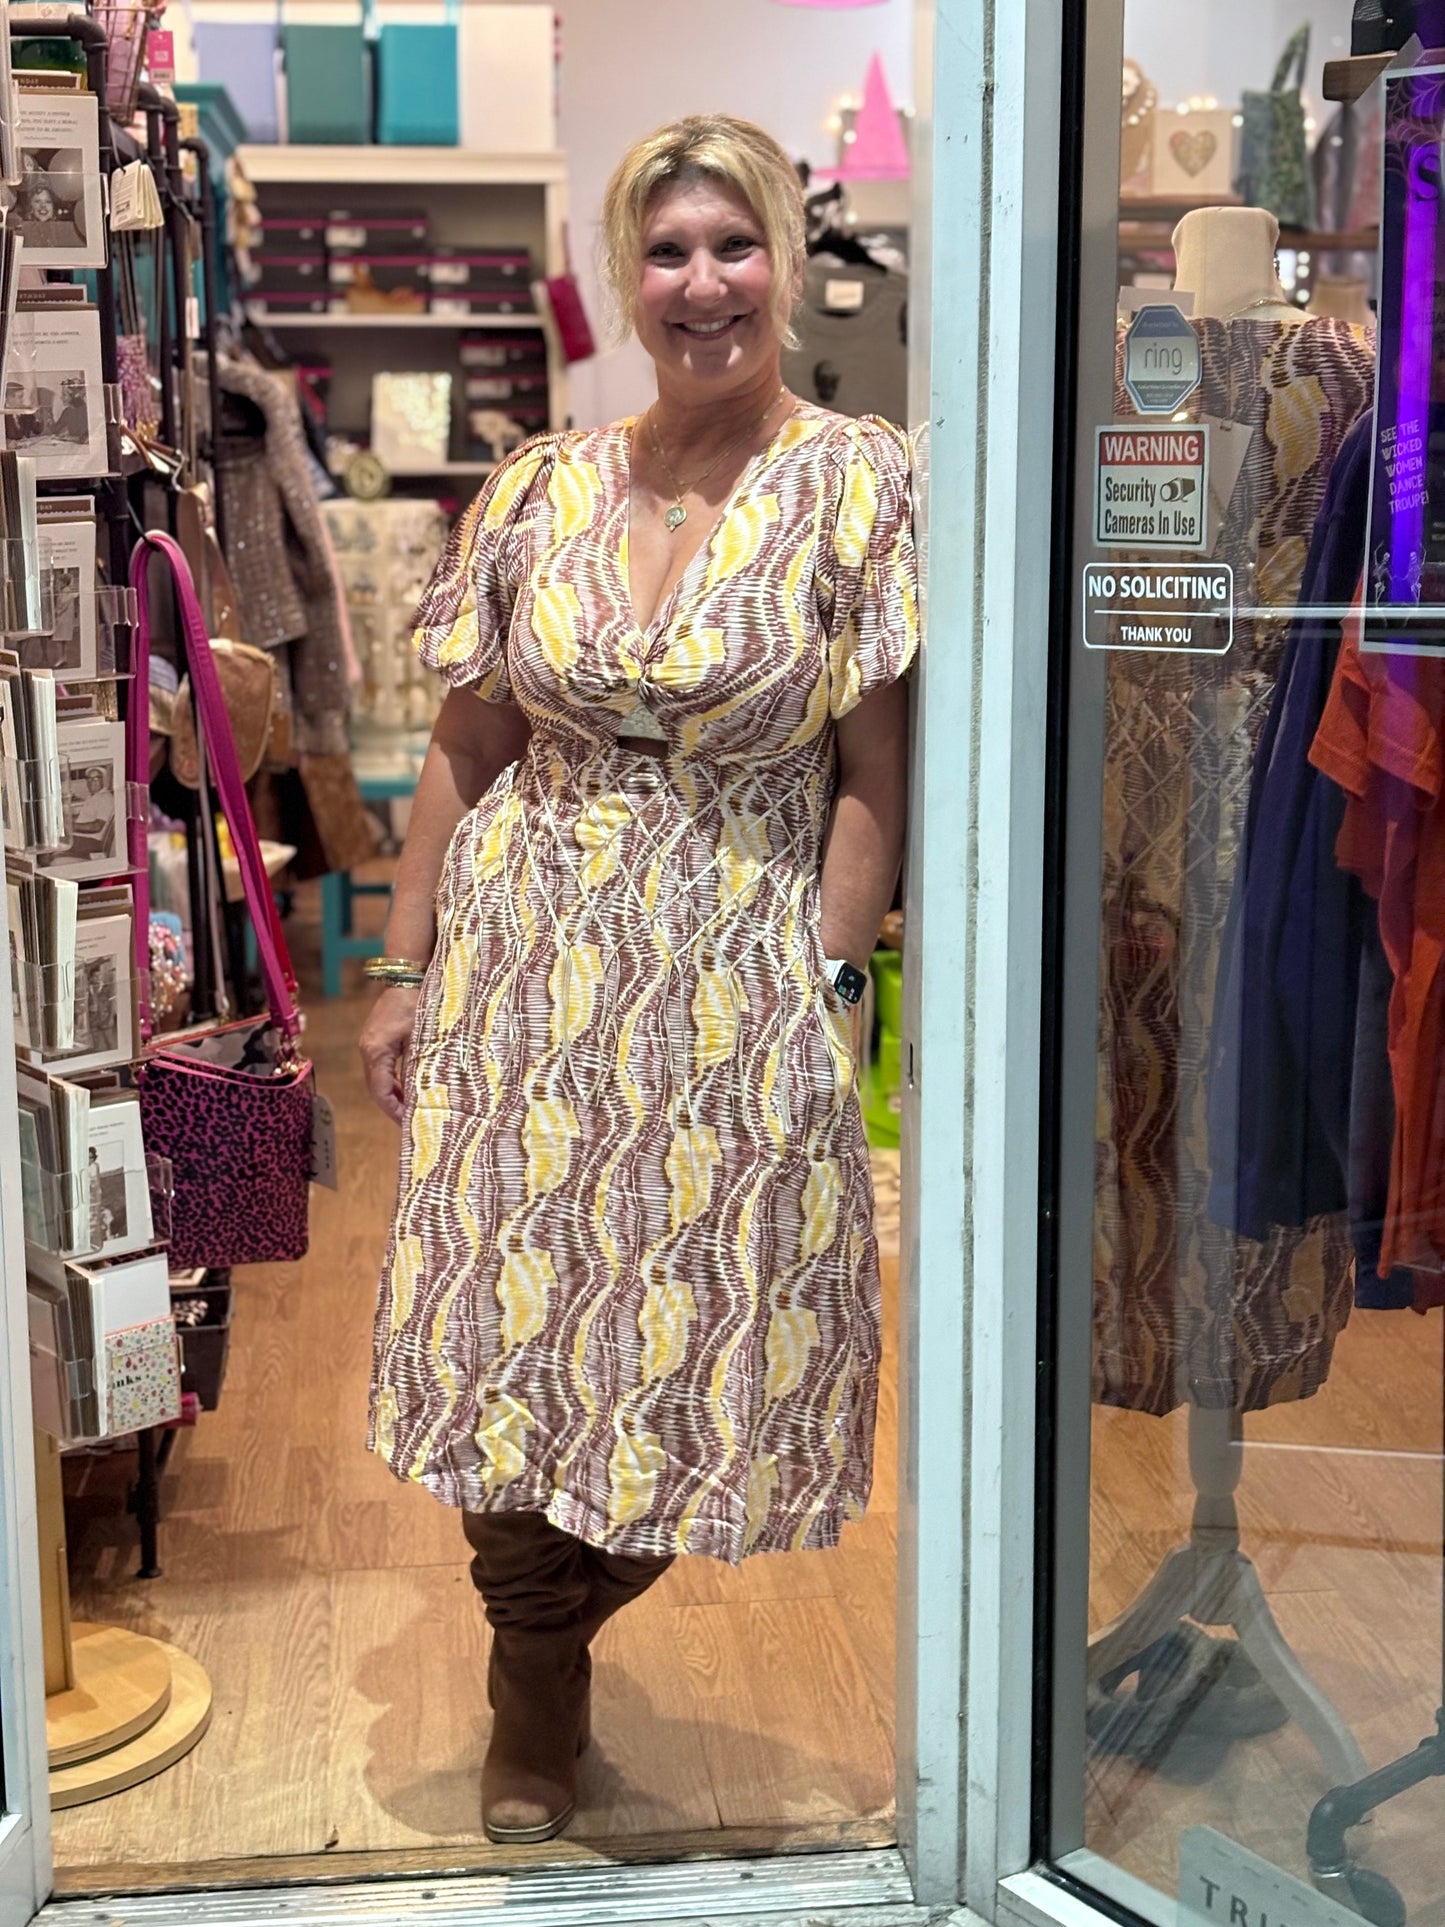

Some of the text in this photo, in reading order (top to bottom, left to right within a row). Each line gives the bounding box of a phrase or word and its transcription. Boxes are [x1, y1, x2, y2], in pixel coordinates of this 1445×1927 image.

[1144, 342, 1183, 375] ring
[1381, 419, 1421, 443] SEE THE
[1104, 435, 1199, 462] WARNING
[1382, 437, 1423, 461] WICKED
[1385, 455, 1423, 478] WOMEN
[1105, 476, 1156, 508] Security
[1389, 473, 1423, 496] DANCE
[1105, 508, 1196, 536] Cameras In Use
[1088, 575, 1227, 600] NO SOLICITING
[1120, 625, 1192, 643] THANK YOU
